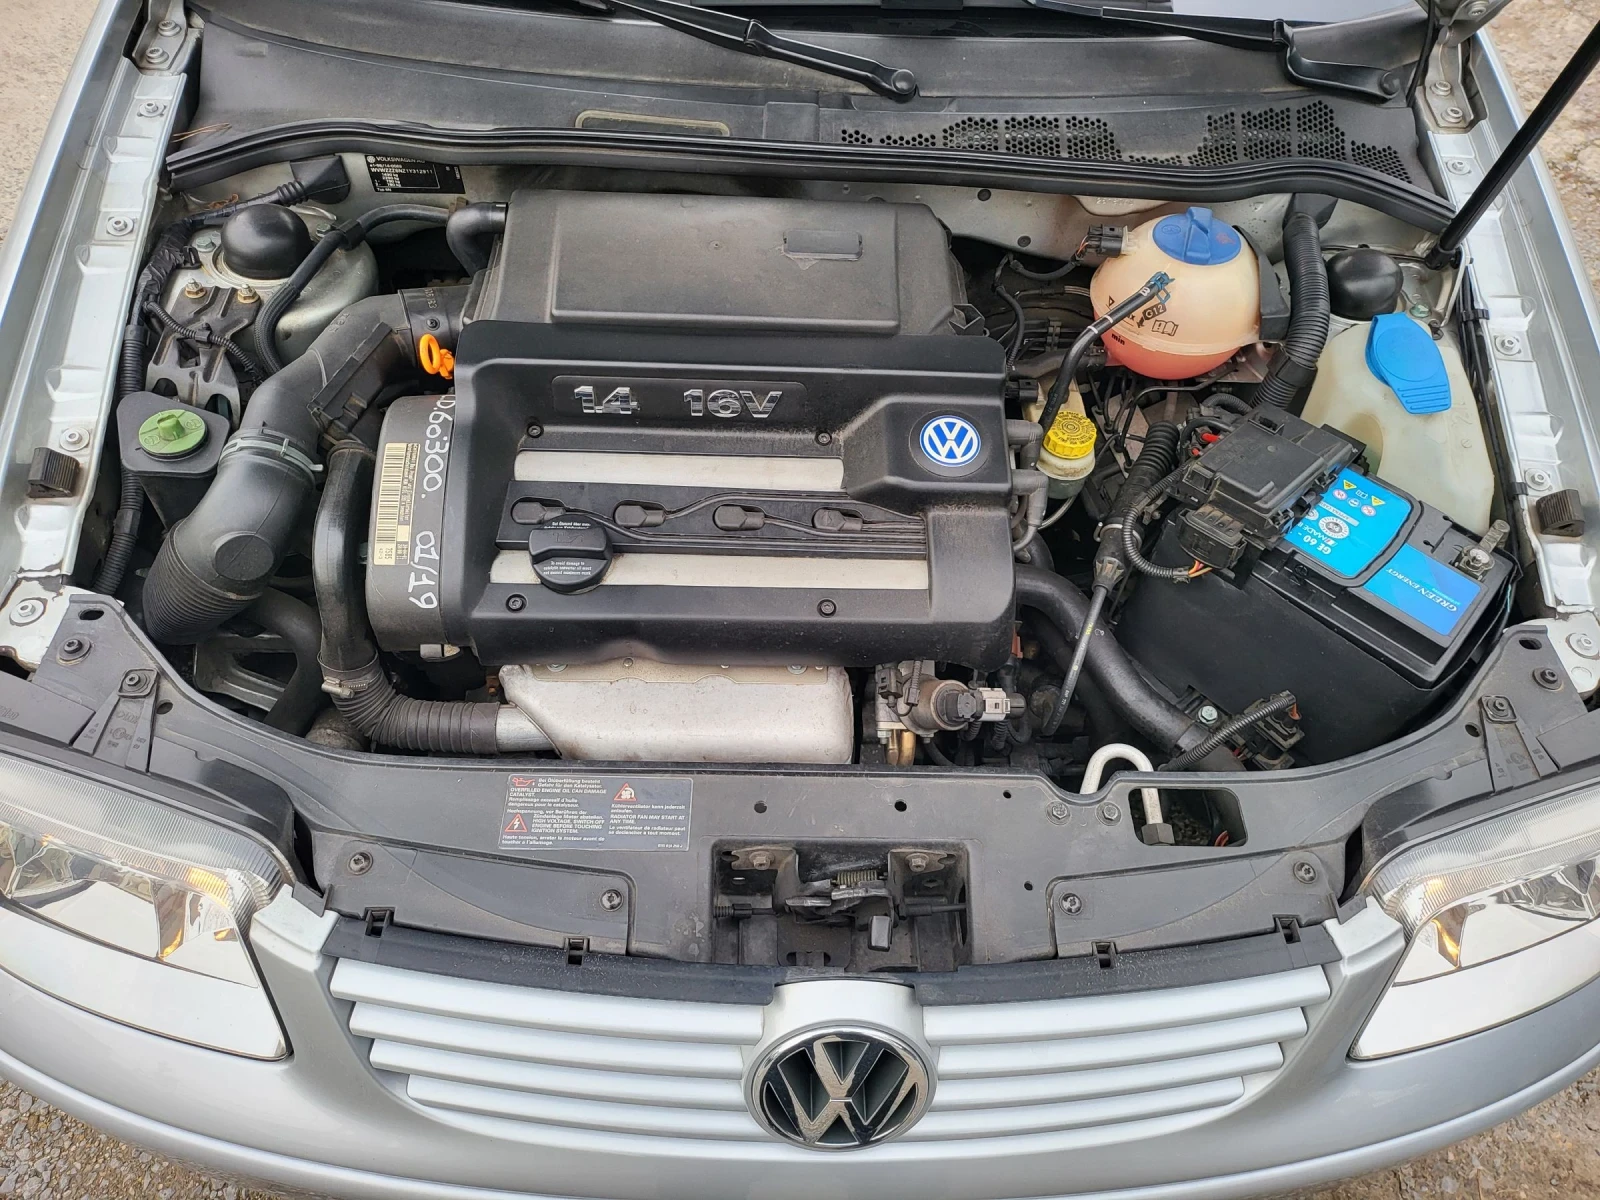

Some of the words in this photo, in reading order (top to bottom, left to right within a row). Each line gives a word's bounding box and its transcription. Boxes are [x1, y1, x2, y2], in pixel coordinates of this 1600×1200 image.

[1146, 304, 1165, 318] G12
[1111, 332, 1125, 345] min
[683, 389, 783, 418] 16V
[920, 416, 980, 466] VW
[1303, 535, 1318, 546] 60
[1304, 524, 1325, 541] MADE
[1316, 544, 1331, 555] GE
[408, 530, 439, 608] 01/19
[1386, 568, 1420, 589] ENERGY
[1418, 588, 1457, 612] GREEN
[752, 1024, 929, 1150] VW
